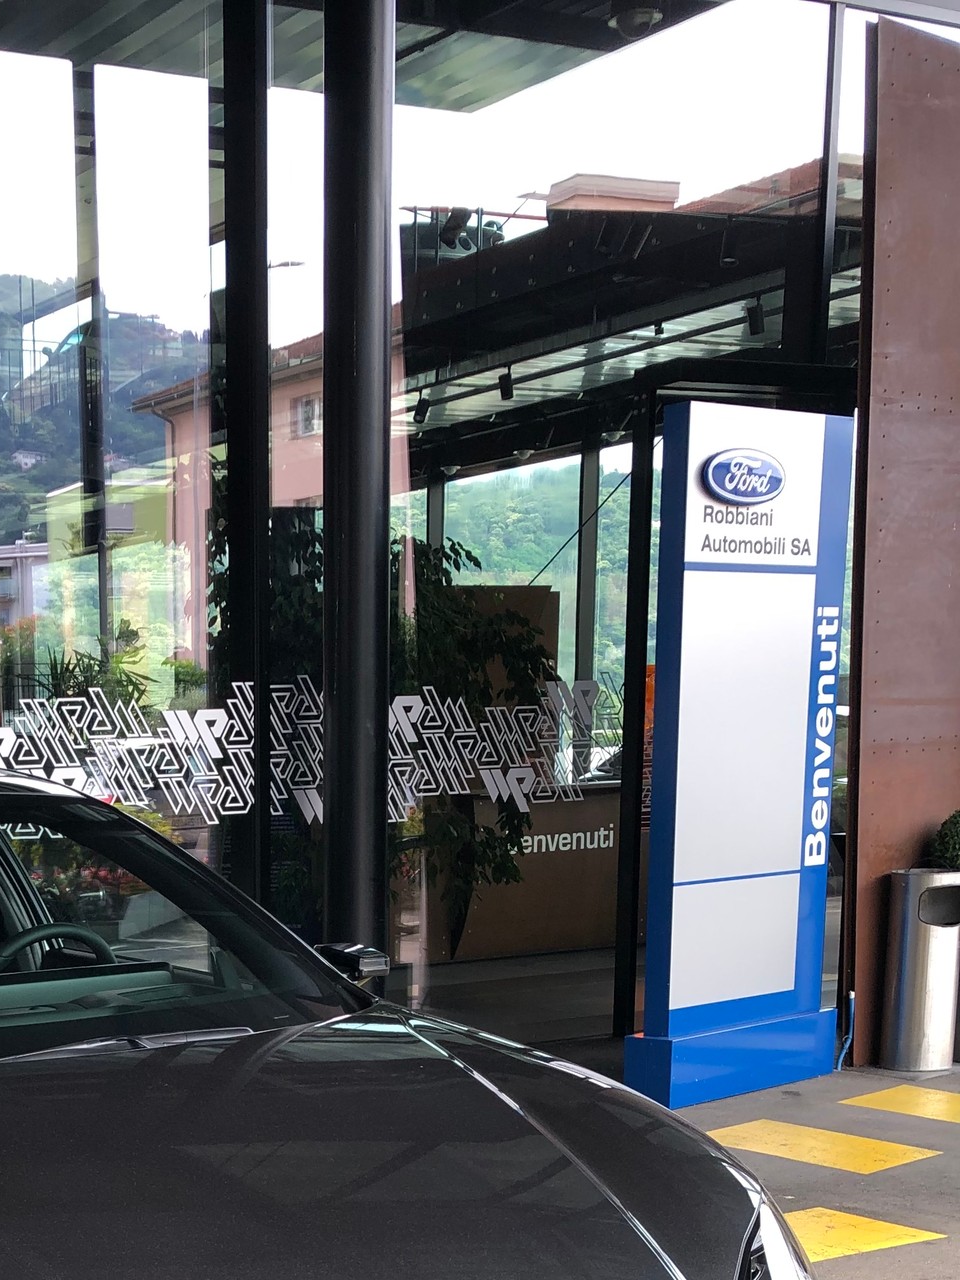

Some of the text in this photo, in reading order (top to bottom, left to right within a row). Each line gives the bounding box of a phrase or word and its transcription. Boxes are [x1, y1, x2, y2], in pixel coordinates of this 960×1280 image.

[724, 456, 772, 494] Ford
[703, 505, 774, 527] Robbiani
[701, 534, 812, 556] Automobili SA
[803, 606, 840, 867] Benvenuti
[508, 824, 615, 855] envenuti
